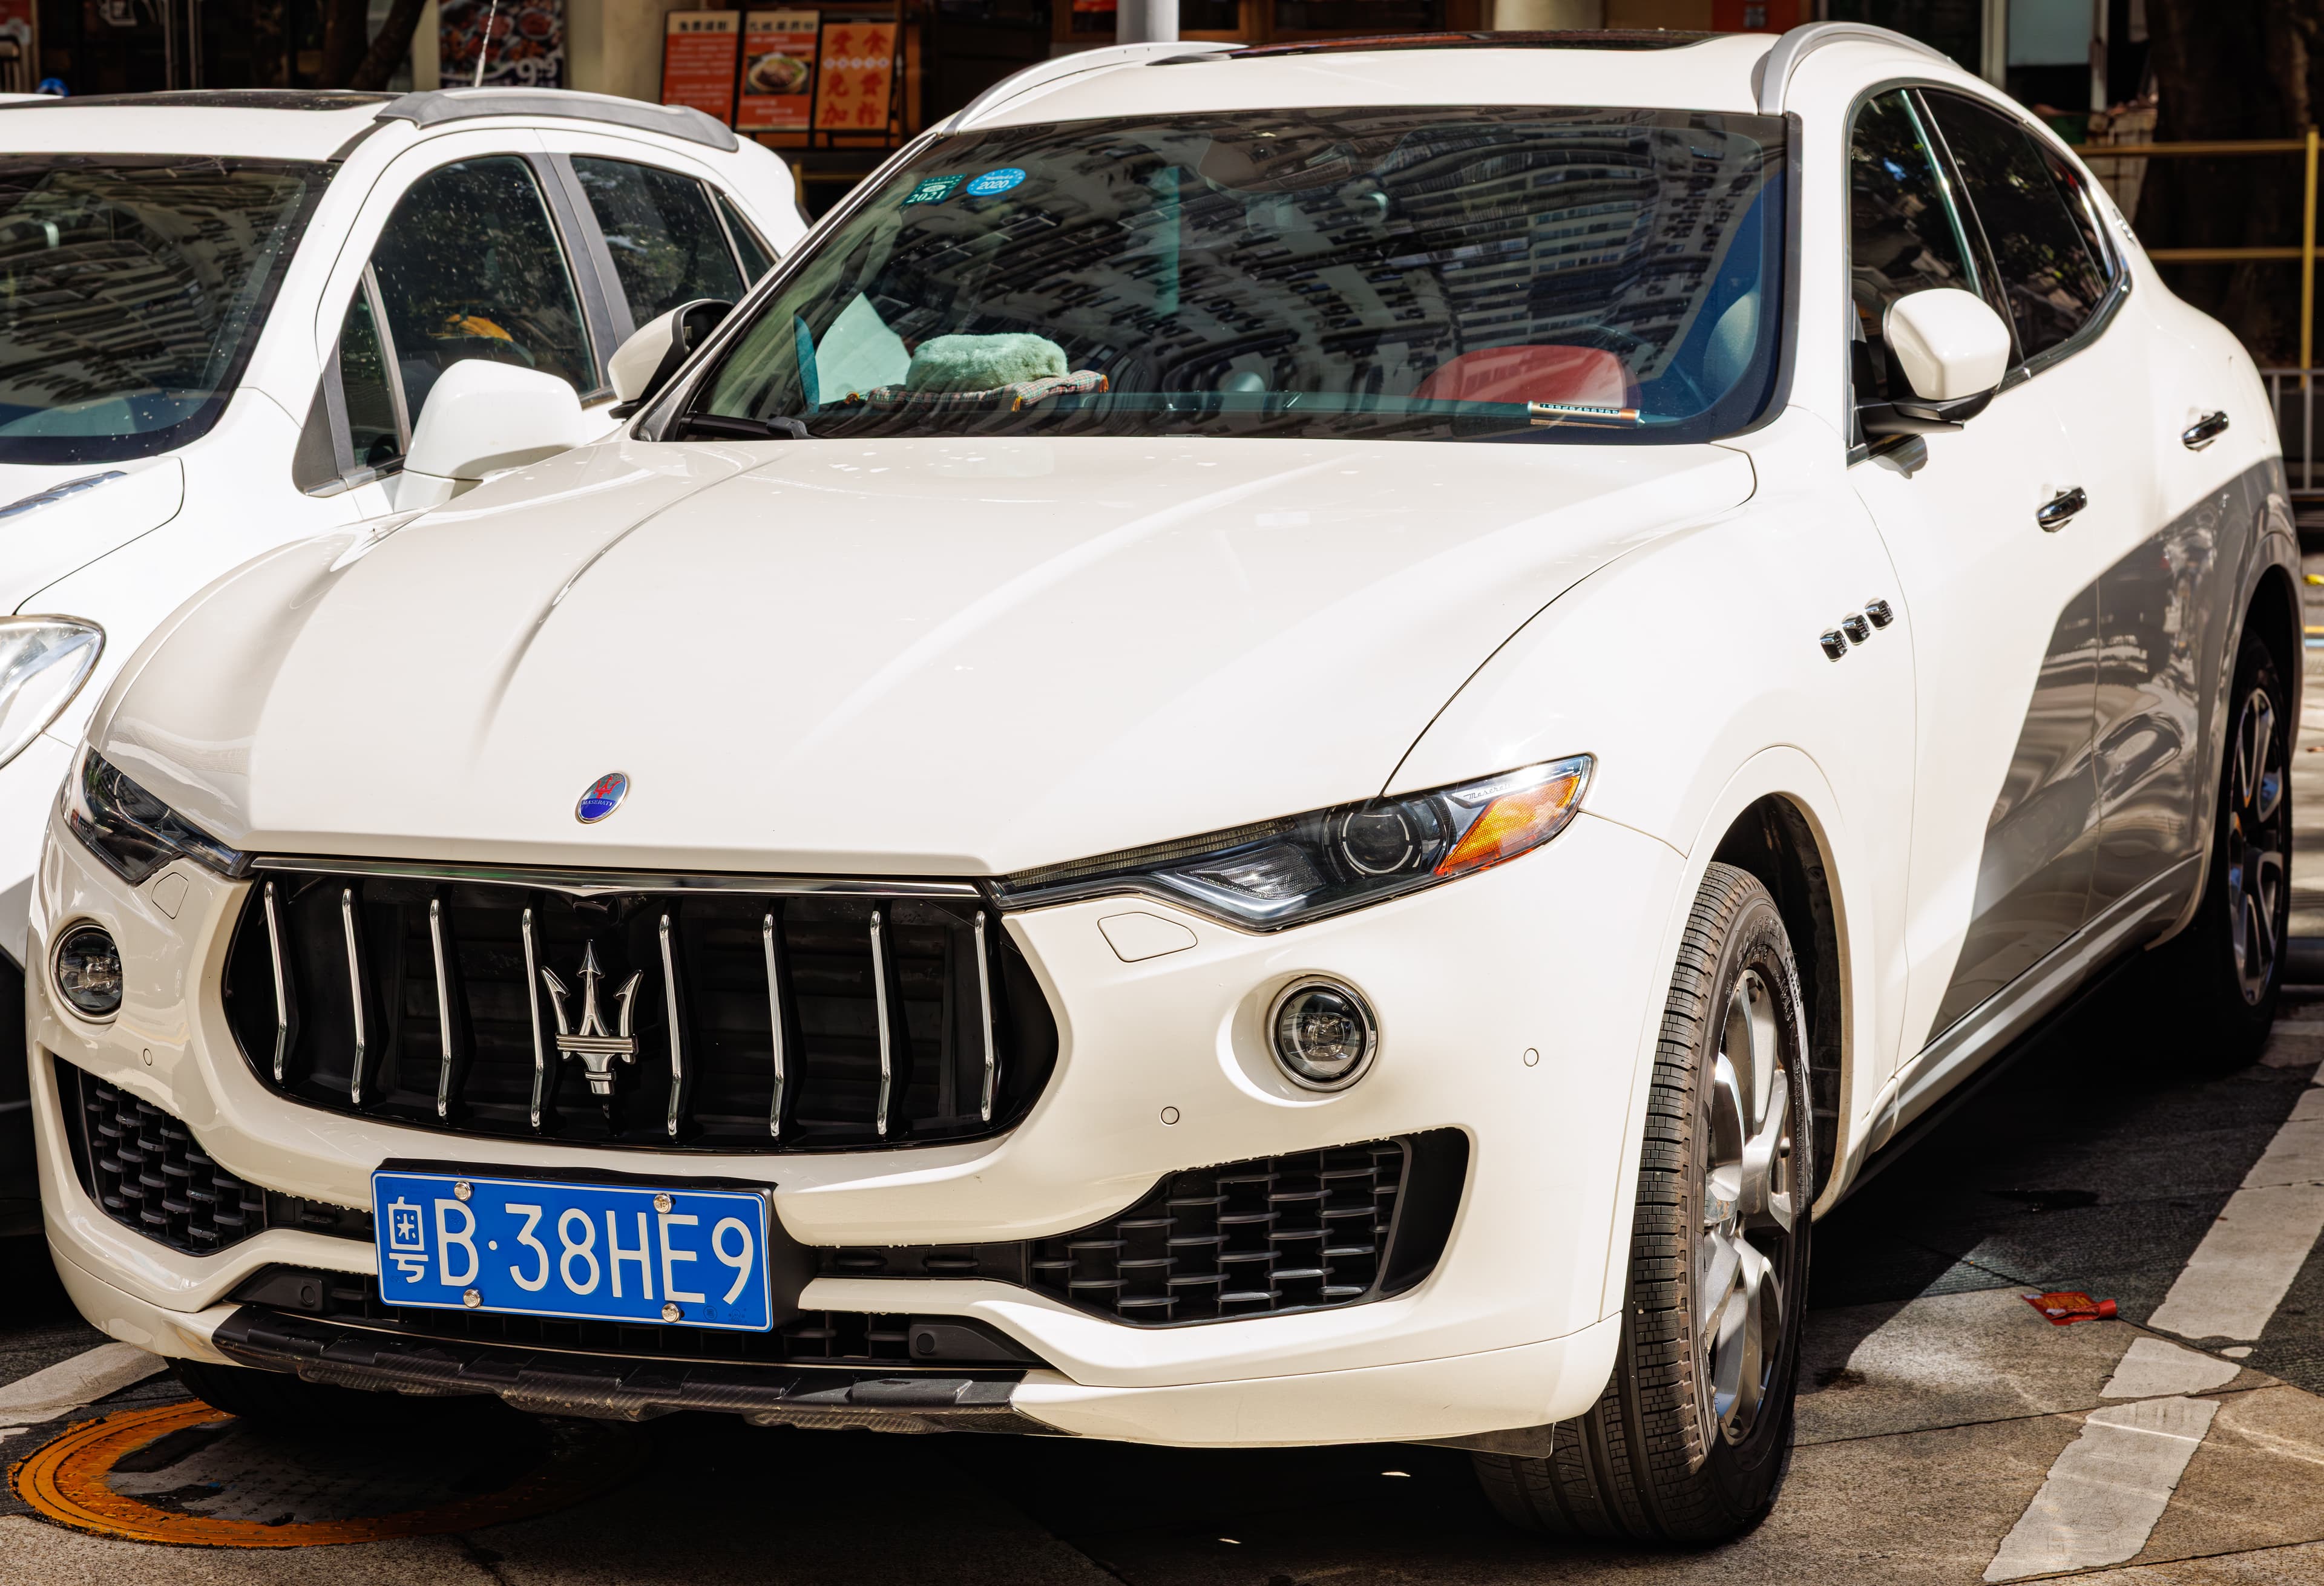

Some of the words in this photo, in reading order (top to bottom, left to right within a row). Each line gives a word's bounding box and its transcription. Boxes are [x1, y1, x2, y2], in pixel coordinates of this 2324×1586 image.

[976, 180, 1009, 190] 2020
[907, 191, 945, 203] 2021
[388, 1196, 754, 1306] 粤B·38HE9
